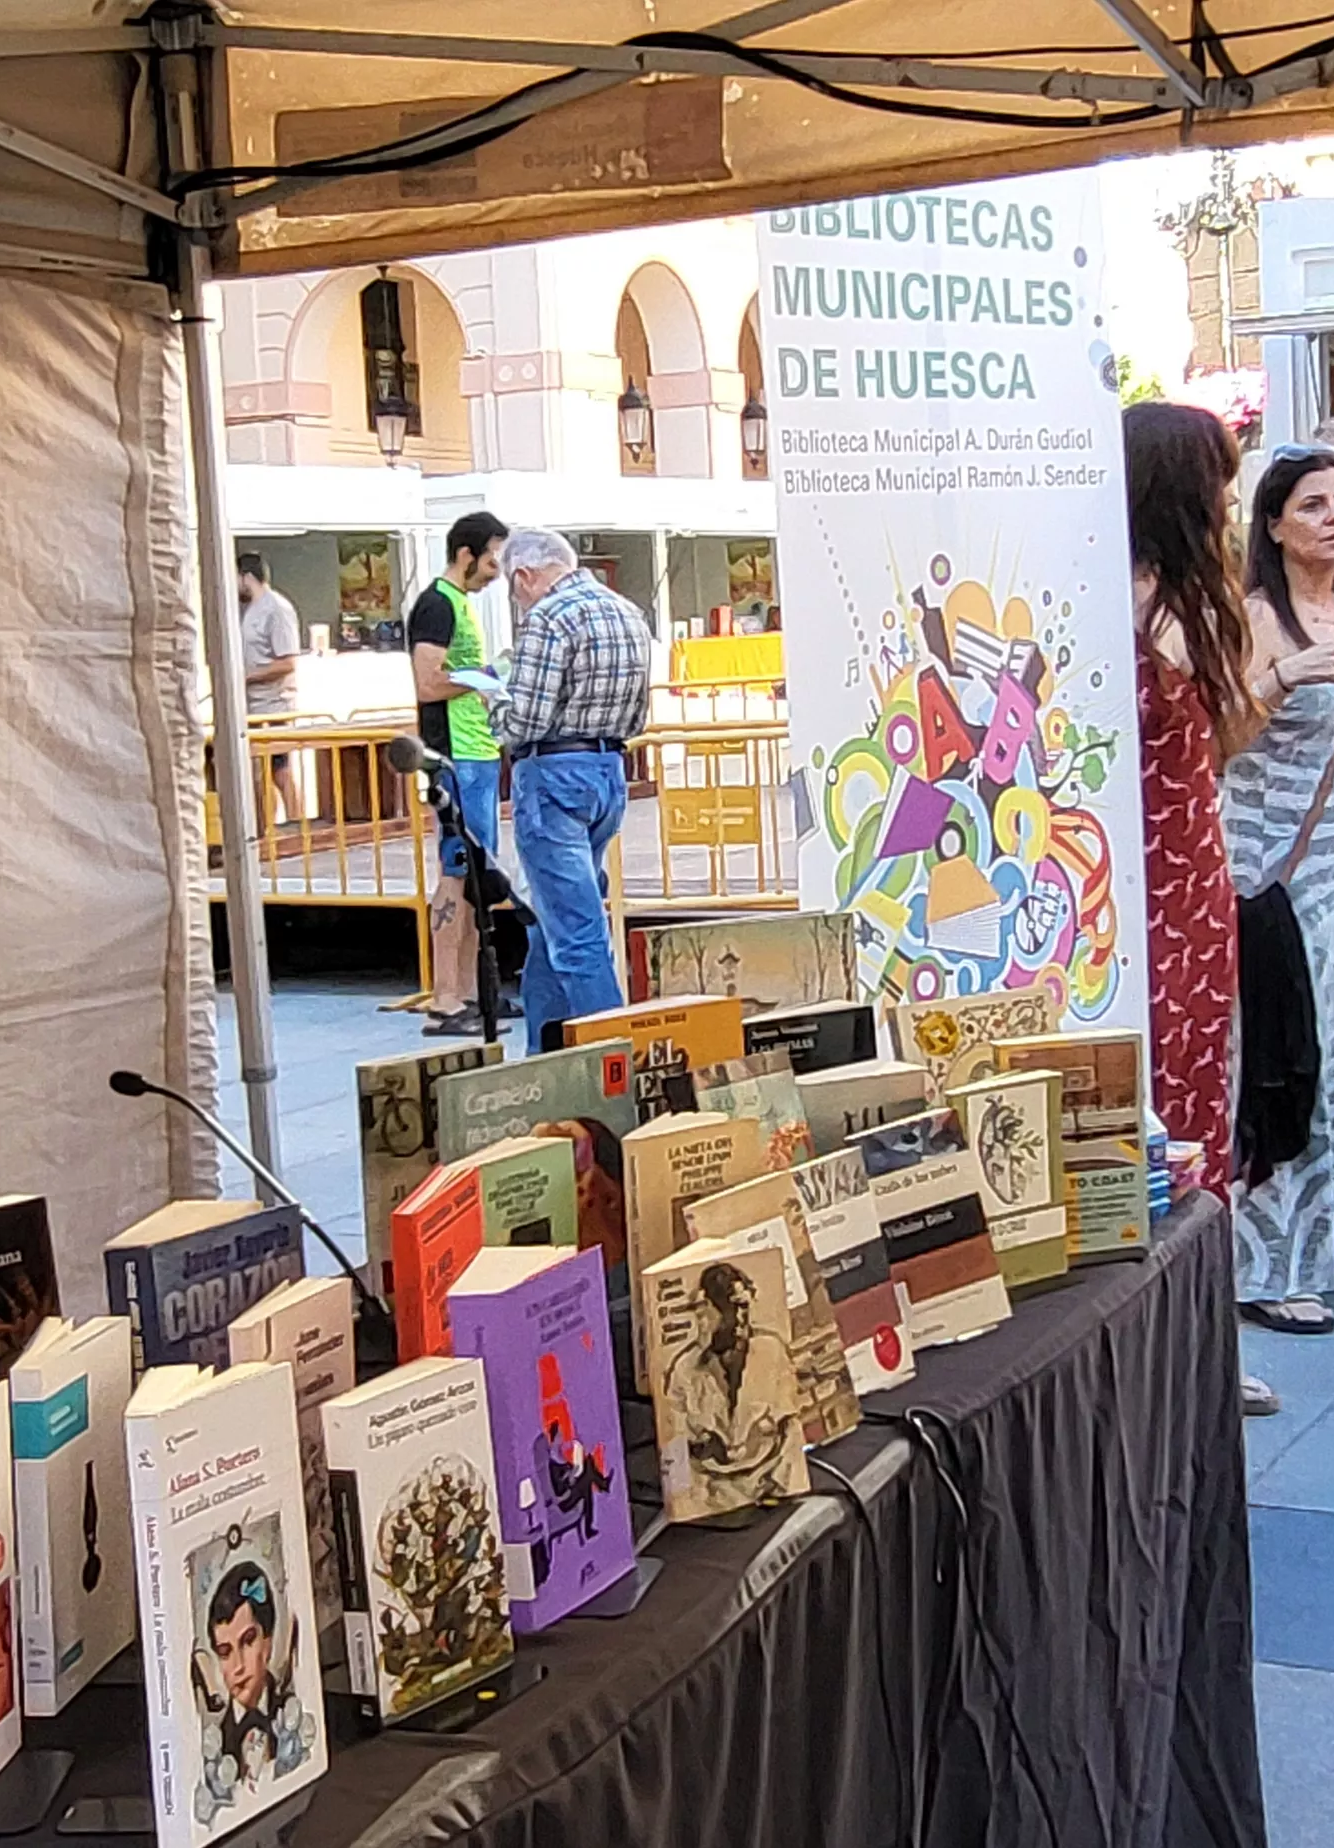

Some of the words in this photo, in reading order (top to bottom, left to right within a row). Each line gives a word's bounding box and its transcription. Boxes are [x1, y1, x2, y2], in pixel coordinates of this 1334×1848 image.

[772, 265, 1074, 327] MUNICIPALES
[777, 347, 840, 398] DE
[855, 349, 1037, 400] HUESCA
[781, 427, 869, 455] Biblioteca
[873, 427, 961, 457] Municipal
[964, 429, 982, 452] A.
[986, 427, 1034, 452] Durán
[1037, 427, 1093, 451] Gudiol
[783, 467, 872, 495] Biblioteca
[875, 465, 963, 494] Municipal
[967, 464, 1024, 488] Ramón
[1025, 465, 1041, 487] J.
[1044, 463, 1108, 487] Sender
